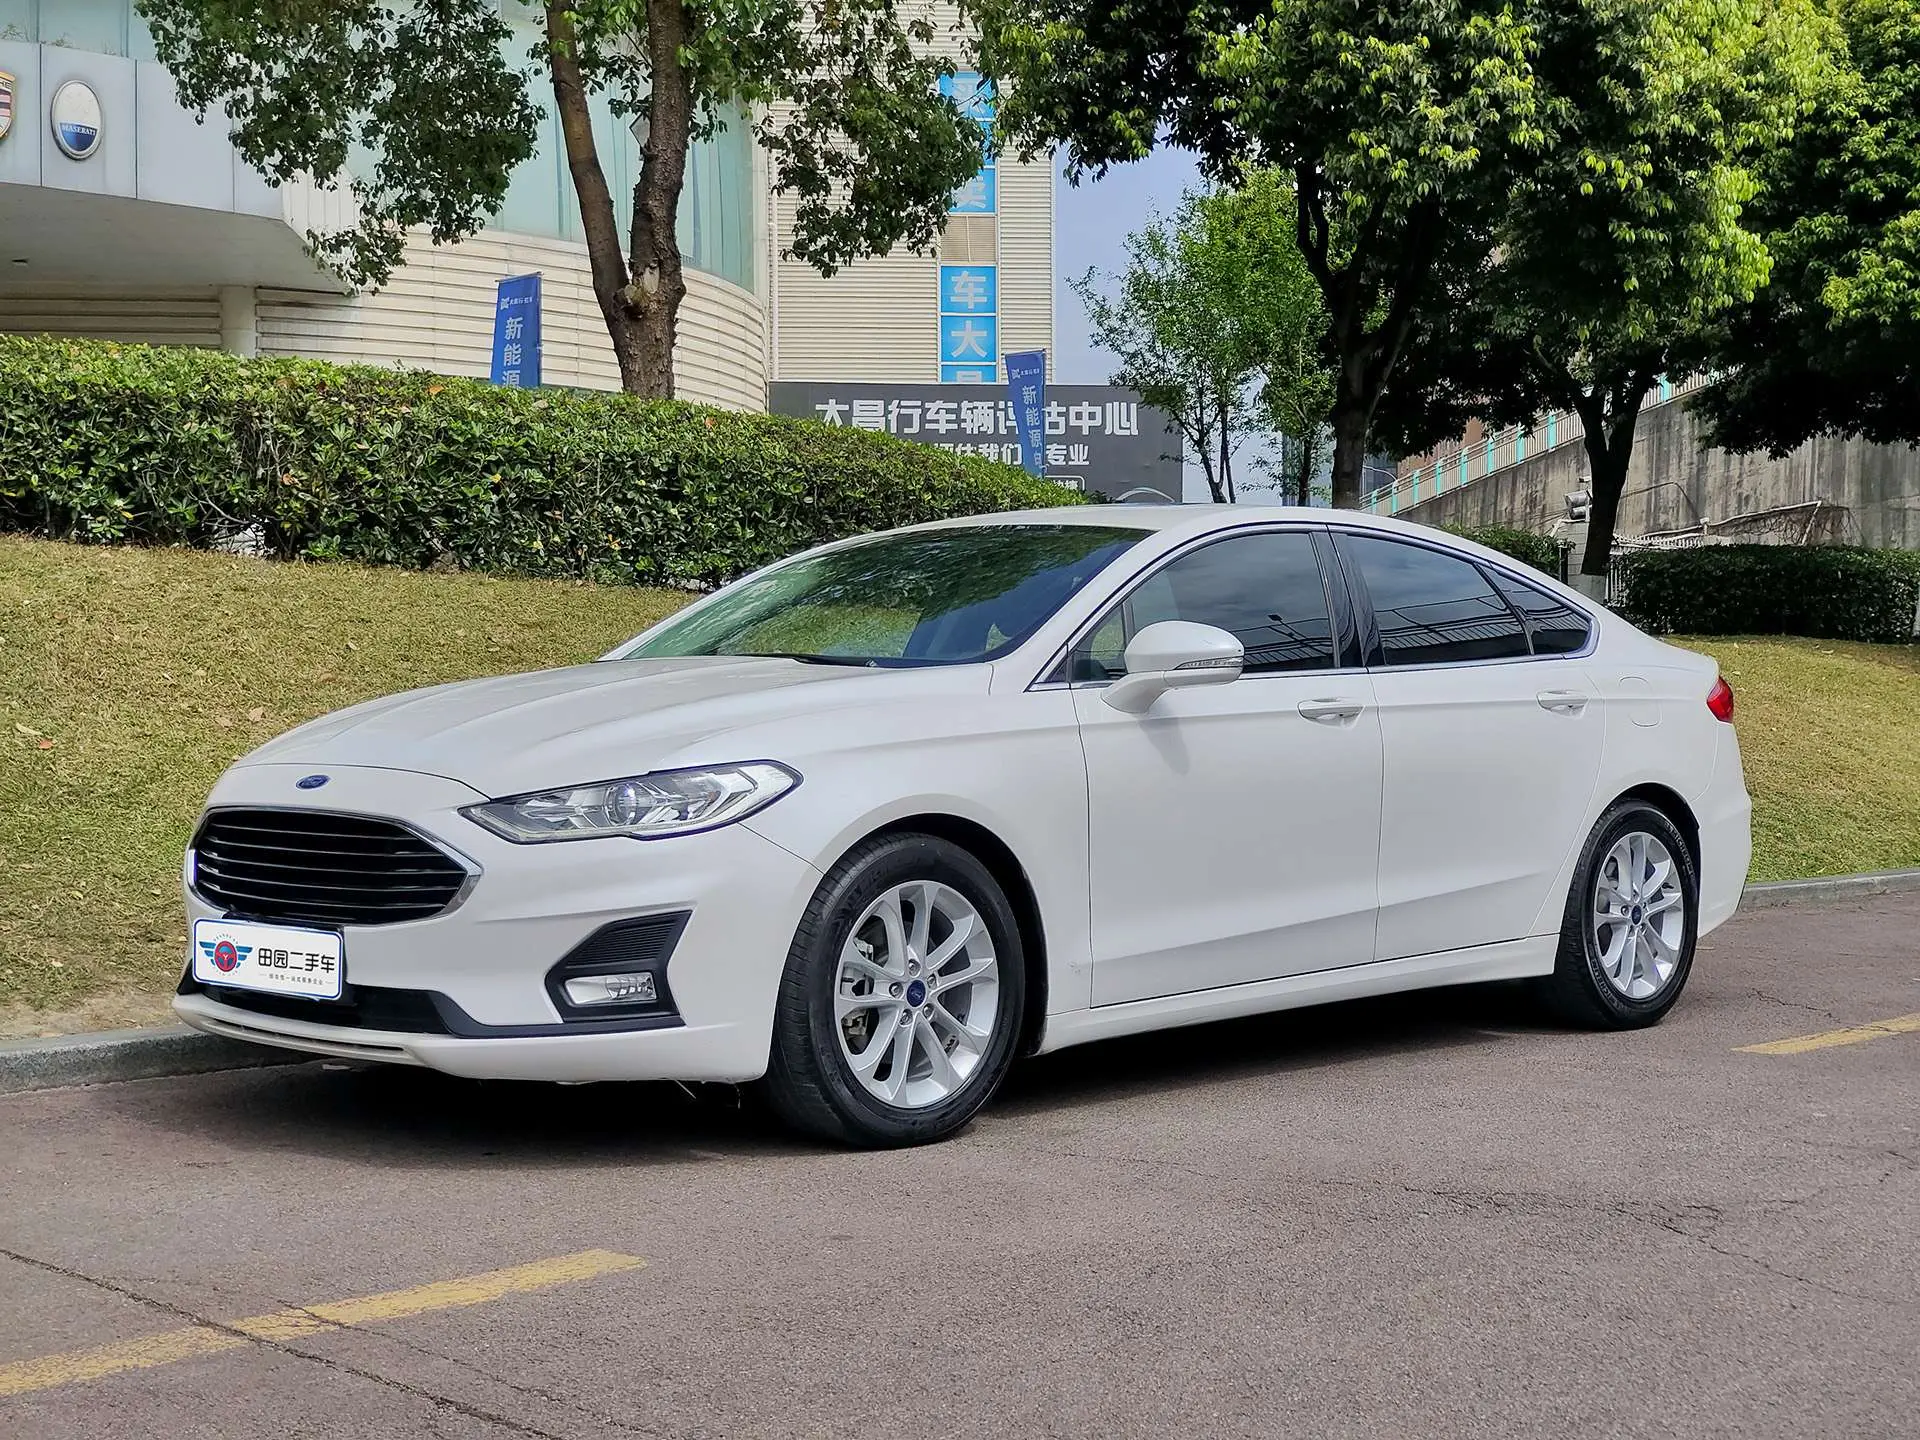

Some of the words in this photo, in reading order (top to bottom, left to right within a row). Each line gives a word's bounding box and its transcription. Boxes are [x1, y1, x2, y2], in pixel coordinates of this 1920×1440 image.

[62, 124, 96, 135] MASERATI
[502, 317, 523, 388] 新能源
[258, 947, 336, 974] 田园二手车
